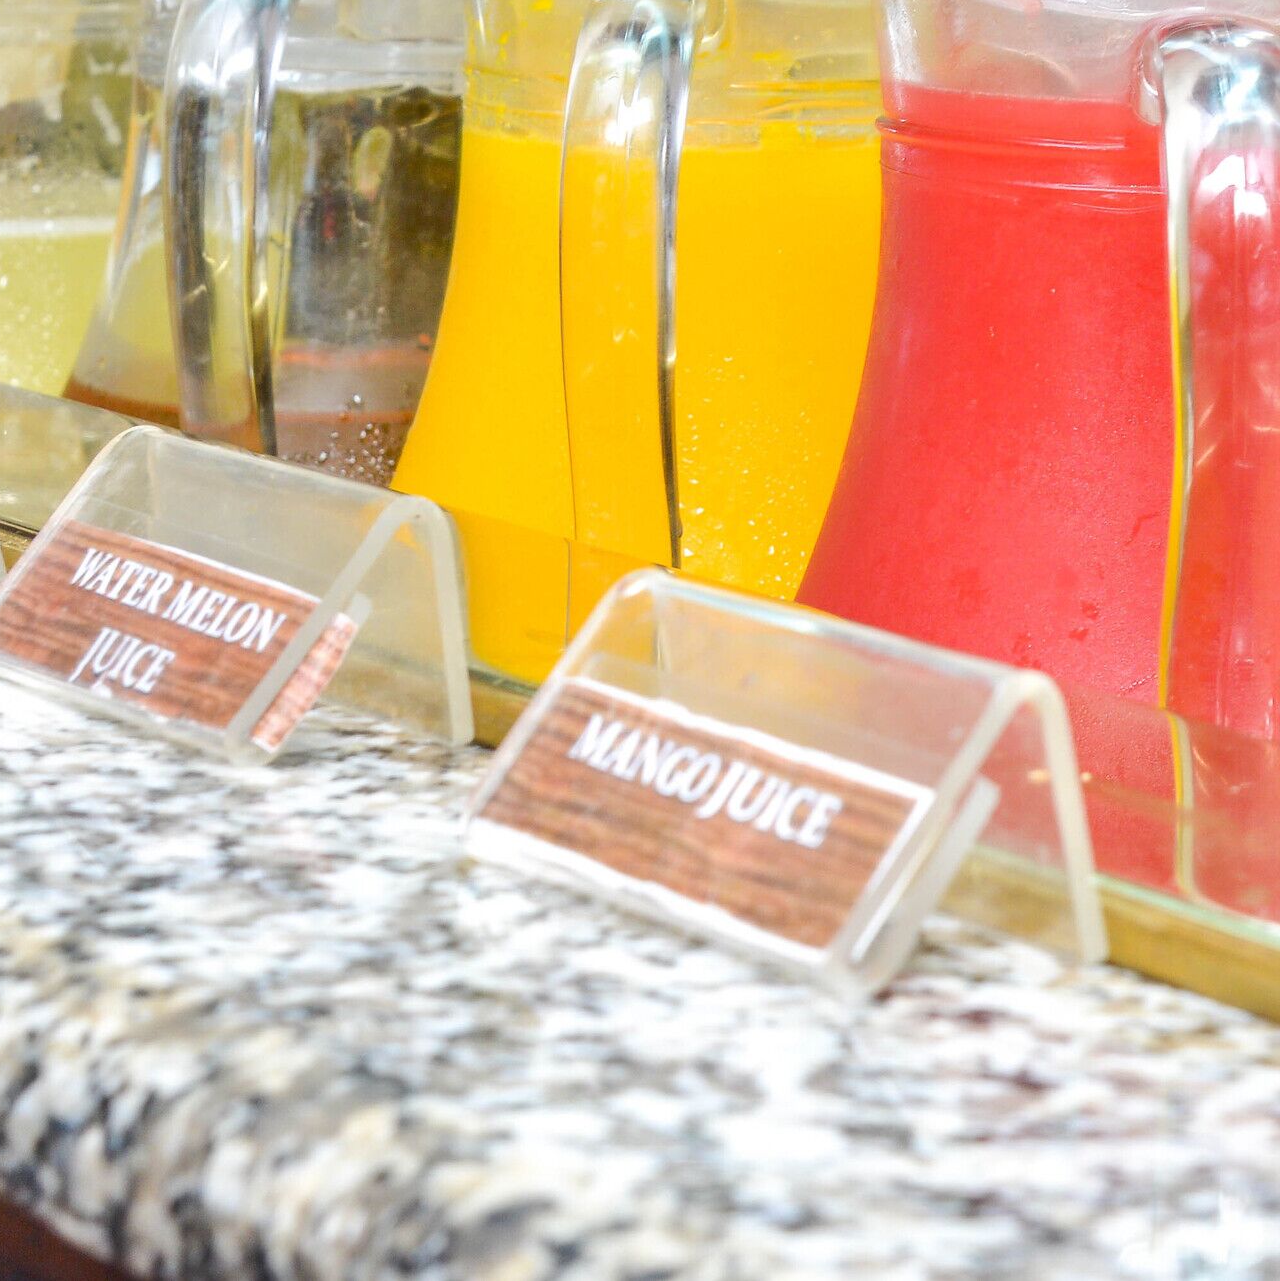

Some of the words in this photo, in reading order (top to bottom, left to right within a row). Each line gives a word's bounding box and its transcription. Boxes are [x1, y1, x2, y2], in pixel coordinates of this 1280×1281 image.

[70, 547, 173, 614] WATER
[162, 579, 287, 653] MELON
[69, 626, 176, 693] JUICE
[566, 713, 721, 803] MANGO
[695, 761, 844, 849] JUICE
